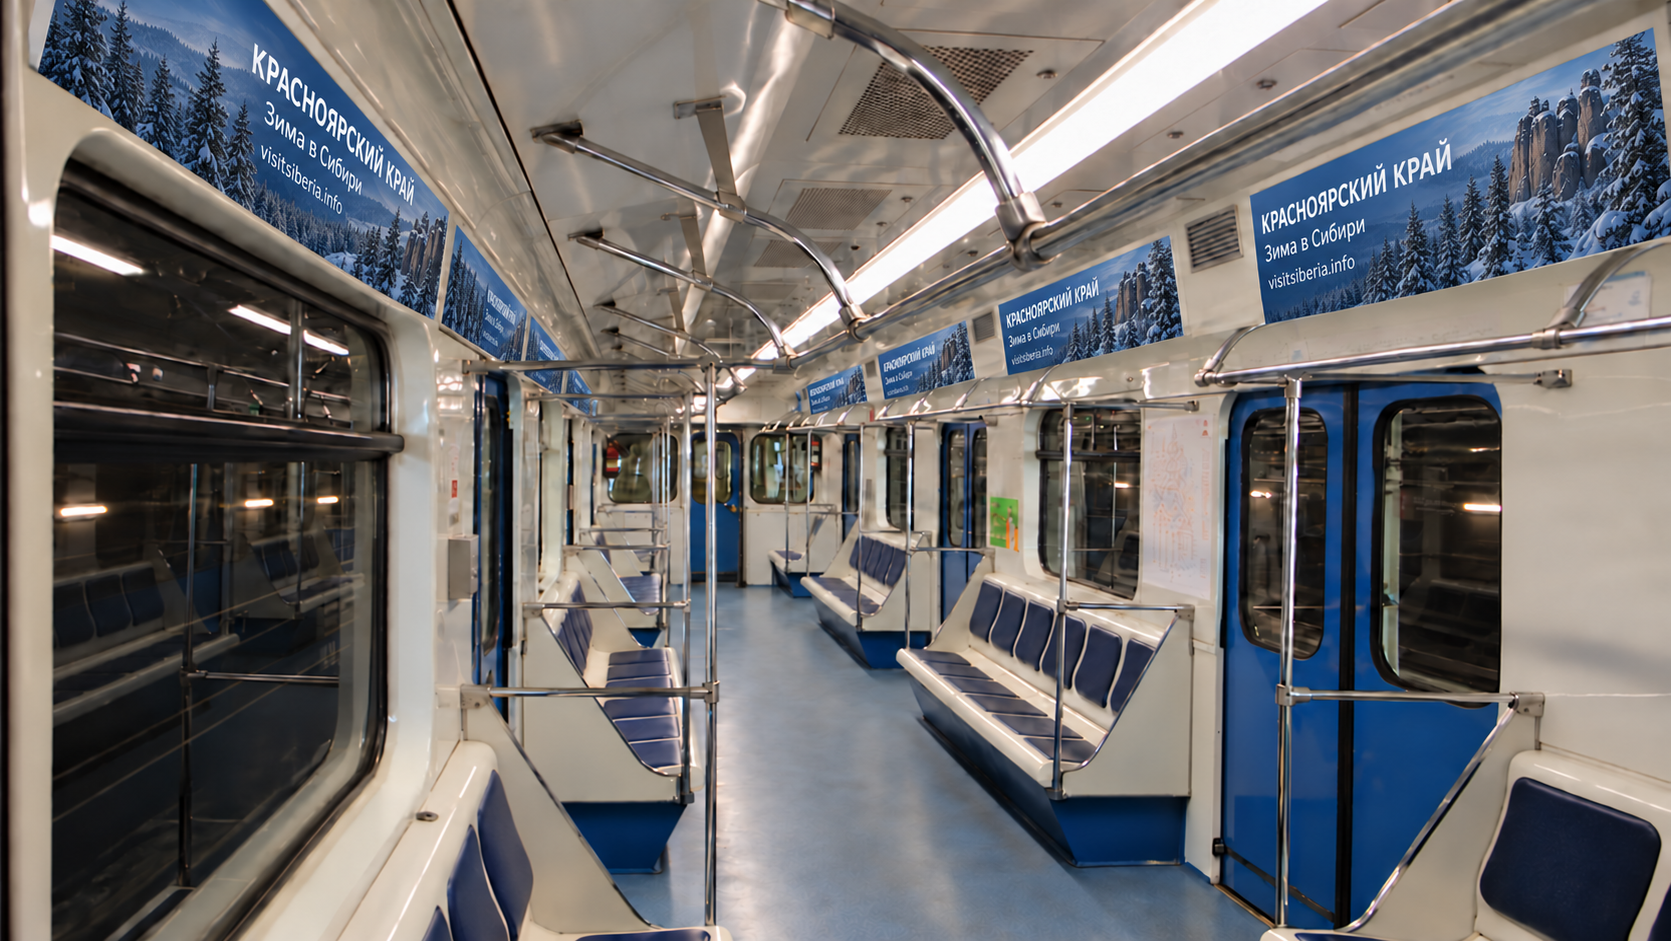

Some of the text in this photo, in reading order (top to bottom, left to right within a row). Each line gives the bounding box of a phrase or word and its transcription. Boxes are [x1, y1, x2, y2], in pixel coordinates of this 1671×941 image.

[252, 43, 415, 206] КРАСНОЯРСКИЙ КРАЙ
[264, 101, 363, 195] Зима в Сибири
[261, 145, 343, 215] visitsiberia.info
[1261, 138, 1452, 234] КРАСНОЯРСКИЙ КРАЙ
[1264, 218, 1366, 262] Зима в Сибири
[1006, 276, 1099, 328] КРАСНОЯРСКИЙ КРАЙ
[1268, 255, 1356, 289] visitsiberia.info
[1008, 335, 1026, 347] Зима
[1032, 322, 1061, 340] Сибири
